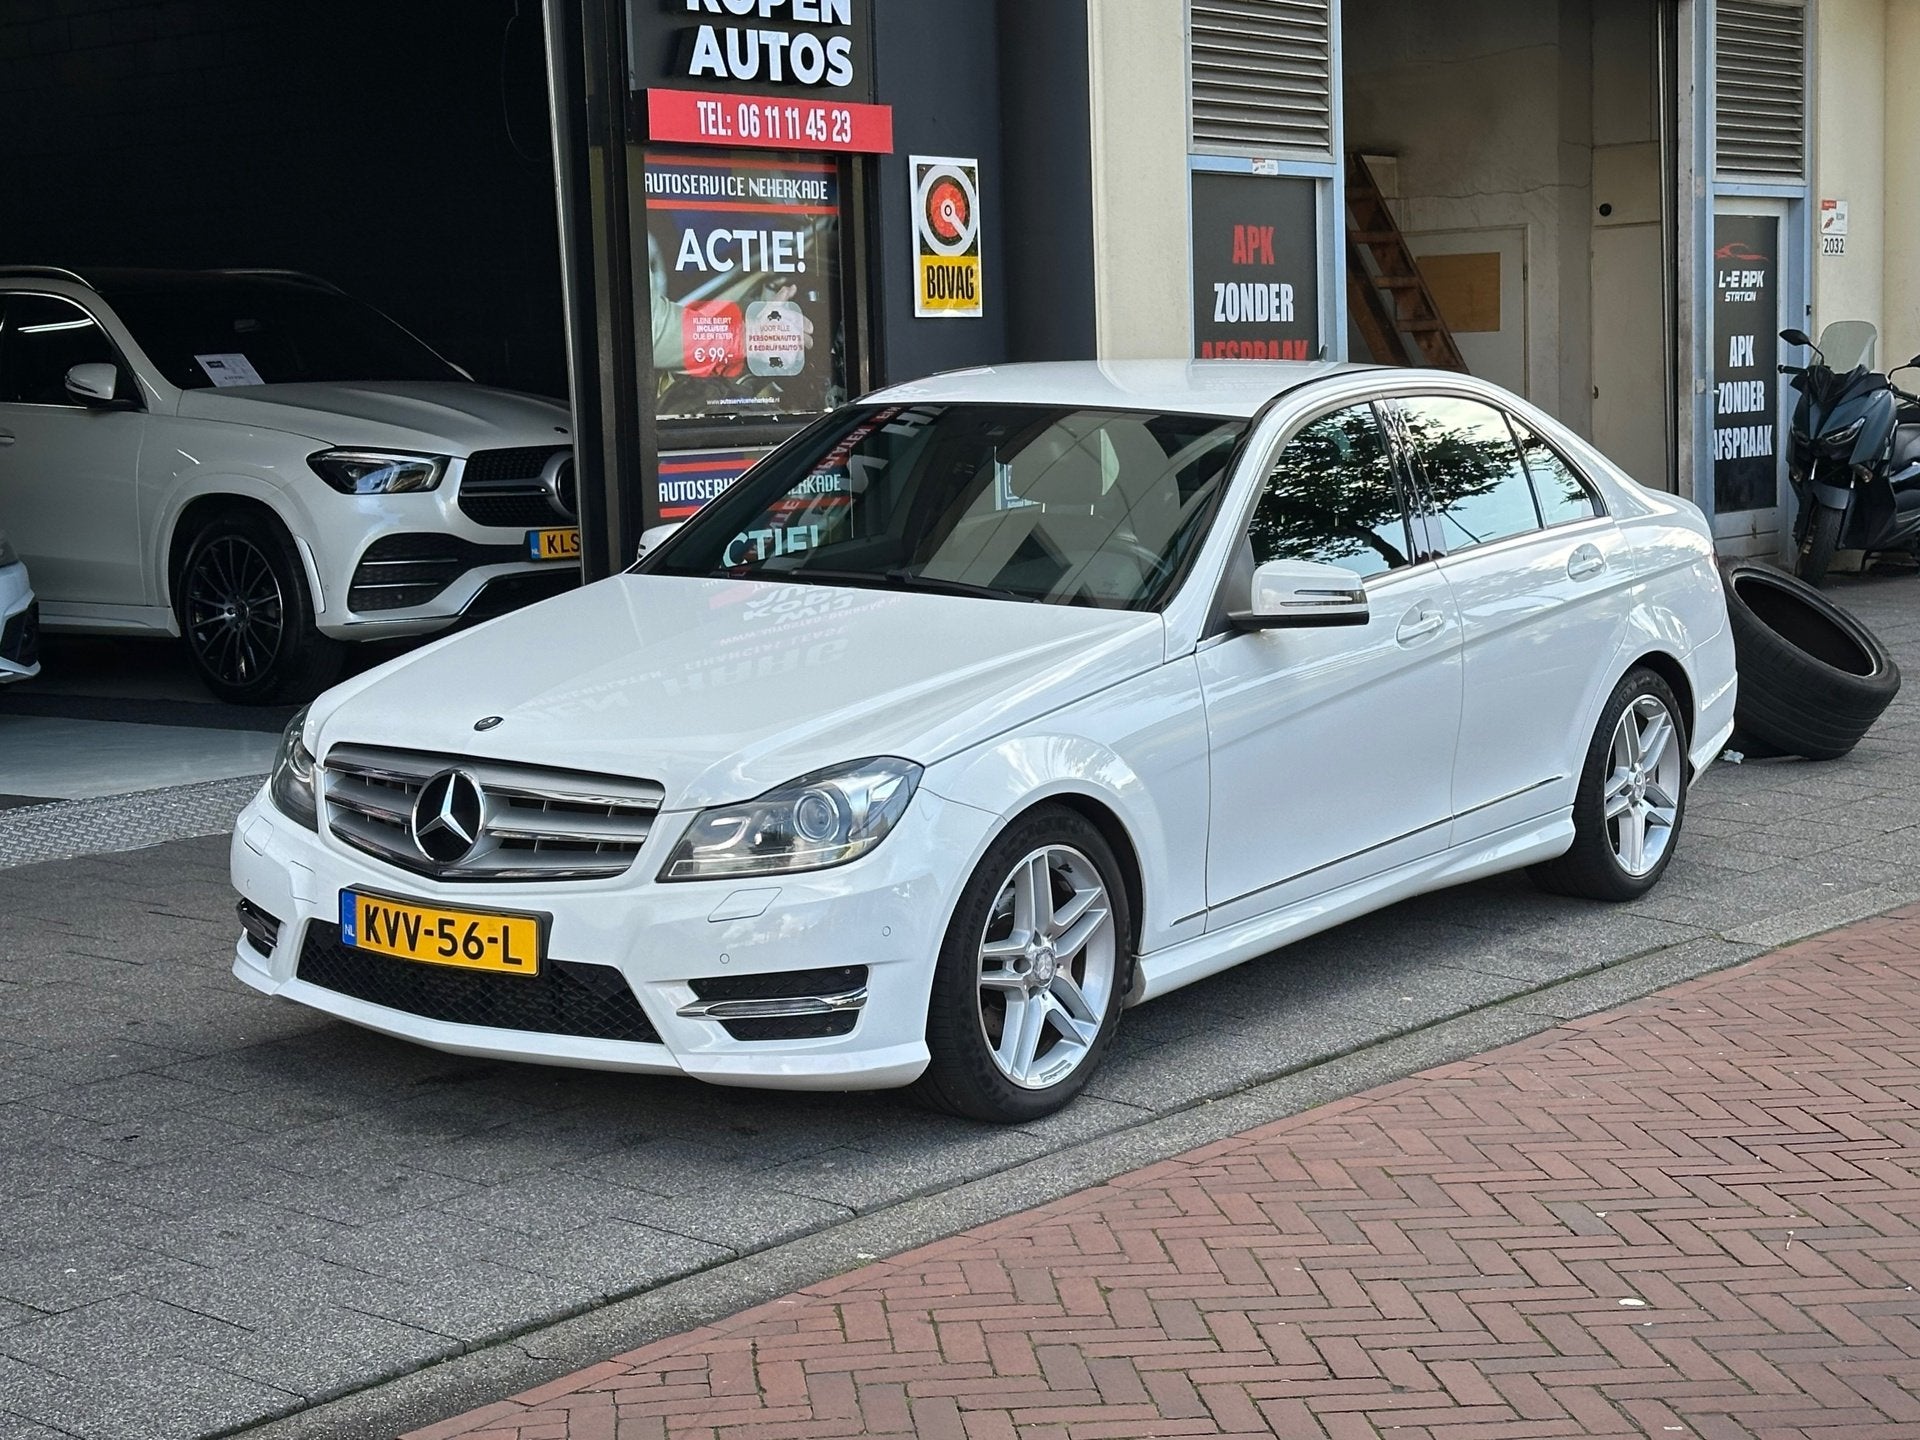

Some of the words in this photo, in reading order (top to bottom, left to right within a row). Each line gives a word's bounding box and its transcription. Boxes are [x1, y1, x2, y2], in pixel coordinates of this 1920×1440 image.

[688, 24, 854, 87] AUTOS
[696, 100, 732, 136] TEL:
[738, 103, 761, 138] 06
[764, 105, 781, 139] 11
[784, 106, 801, 140] 11
[805, 108, 827, 142] 45
[831, 109, 852, 143] 23
[645, 172, 745, 197] AUTOSERVICE
[748, 176, 828, 200] NEHERKADE
[674, 228, 806, 273] ACTIE!
[1232, 224, 1275, 265] APK
[1823, 238, 1845, 254] 2032
[926, 264, 975, 300] BOVAG
[1718, 270, 1740, 288] L-E
[1740, 270, 1765, 288] APK
[1213, 282, 1294, 323] ZONDER
[708, 347, 734, 364] 99,-
[1729, 335, 1755, 368] APK
[1718, 380, 1765, 414] ZONDER
[344, 924, 356, 938] NL
[364, 903, 523, 966] KVV-56-L
